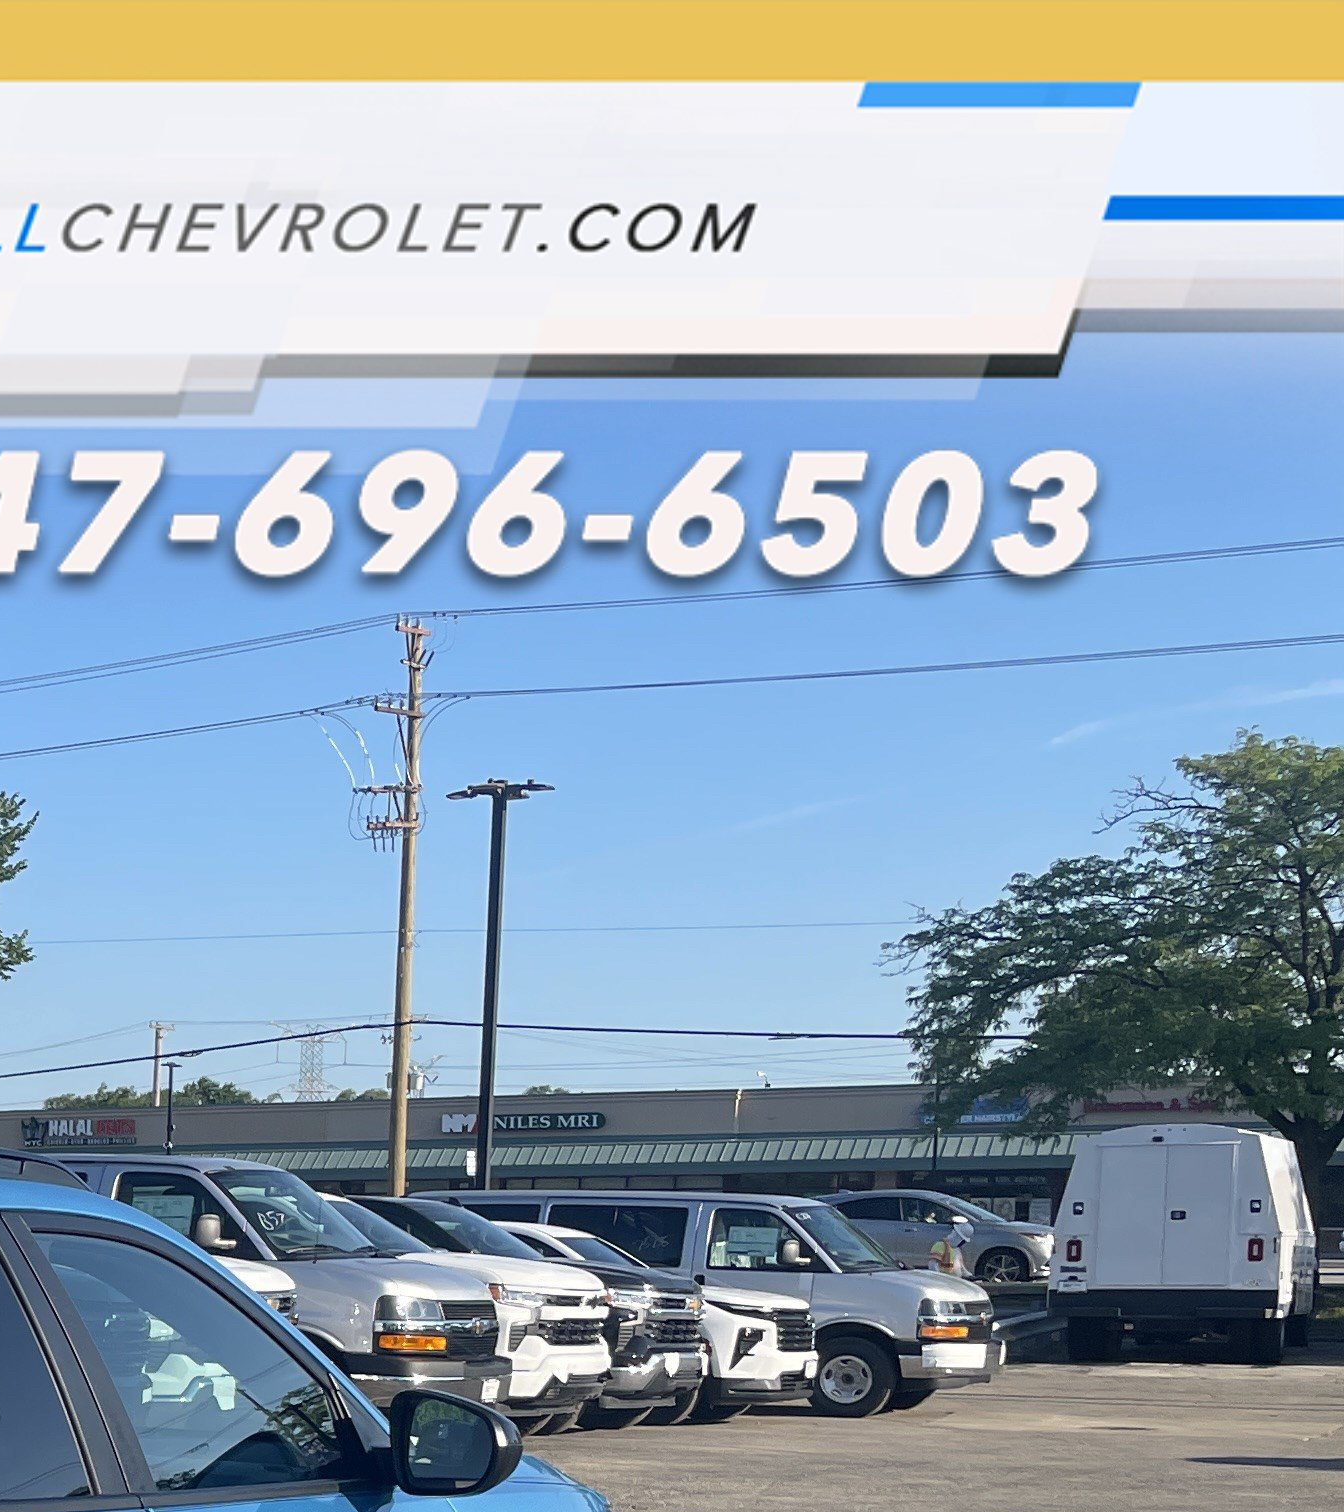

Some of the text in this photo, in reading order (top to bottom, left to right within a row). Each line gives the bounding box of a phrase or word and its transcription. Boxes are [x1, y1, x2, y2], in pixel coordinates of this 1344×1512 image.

[48, 1119, 93, 1136] HALAL
[494, 1114, 599, 1129] NILES MRI
[256, 1210, 285, 1231] B57
